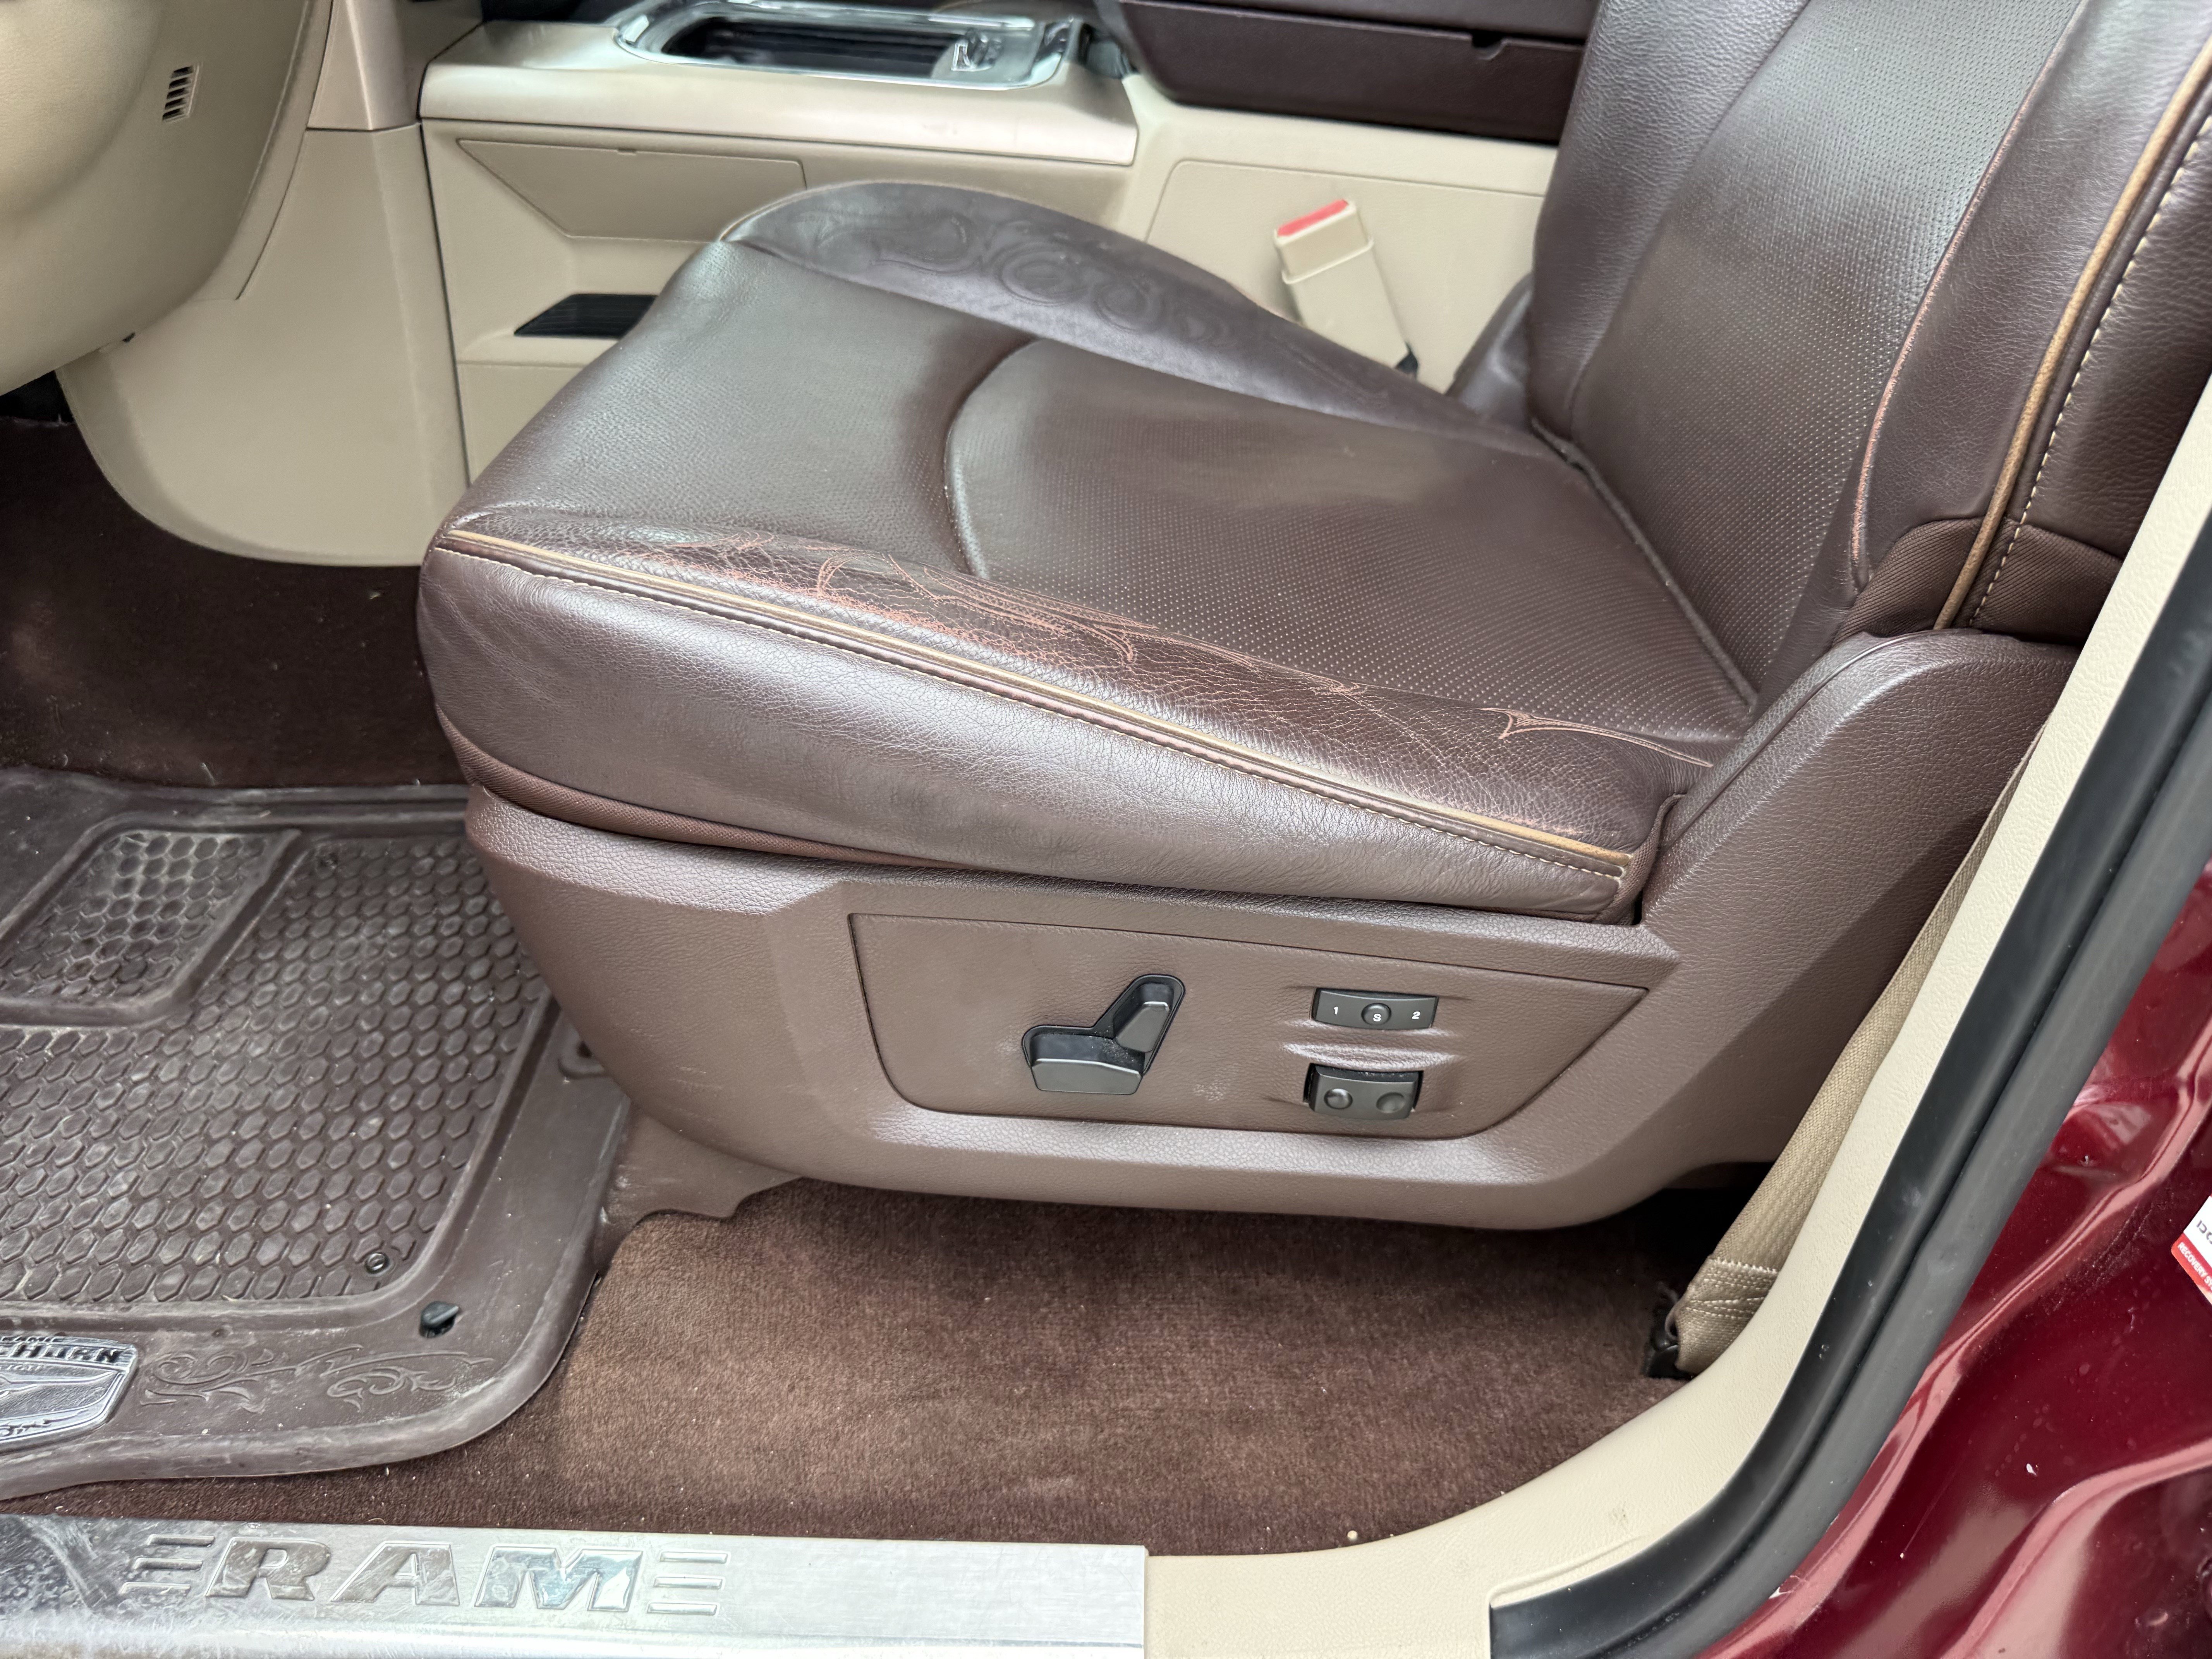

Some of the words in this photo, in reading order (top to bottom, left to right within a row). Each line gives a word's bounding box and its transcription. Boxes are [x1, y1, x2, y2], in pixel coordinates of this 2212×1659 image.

[1333, 1006, 1338, 1015] 1
[1373, 1013, 1382, 1022] S
[1412, 1011, 1421, 1020] 2
[2177, 1242, 2208, 1278] RECOVERY
[204, 1536, 644, 1612] RAM
